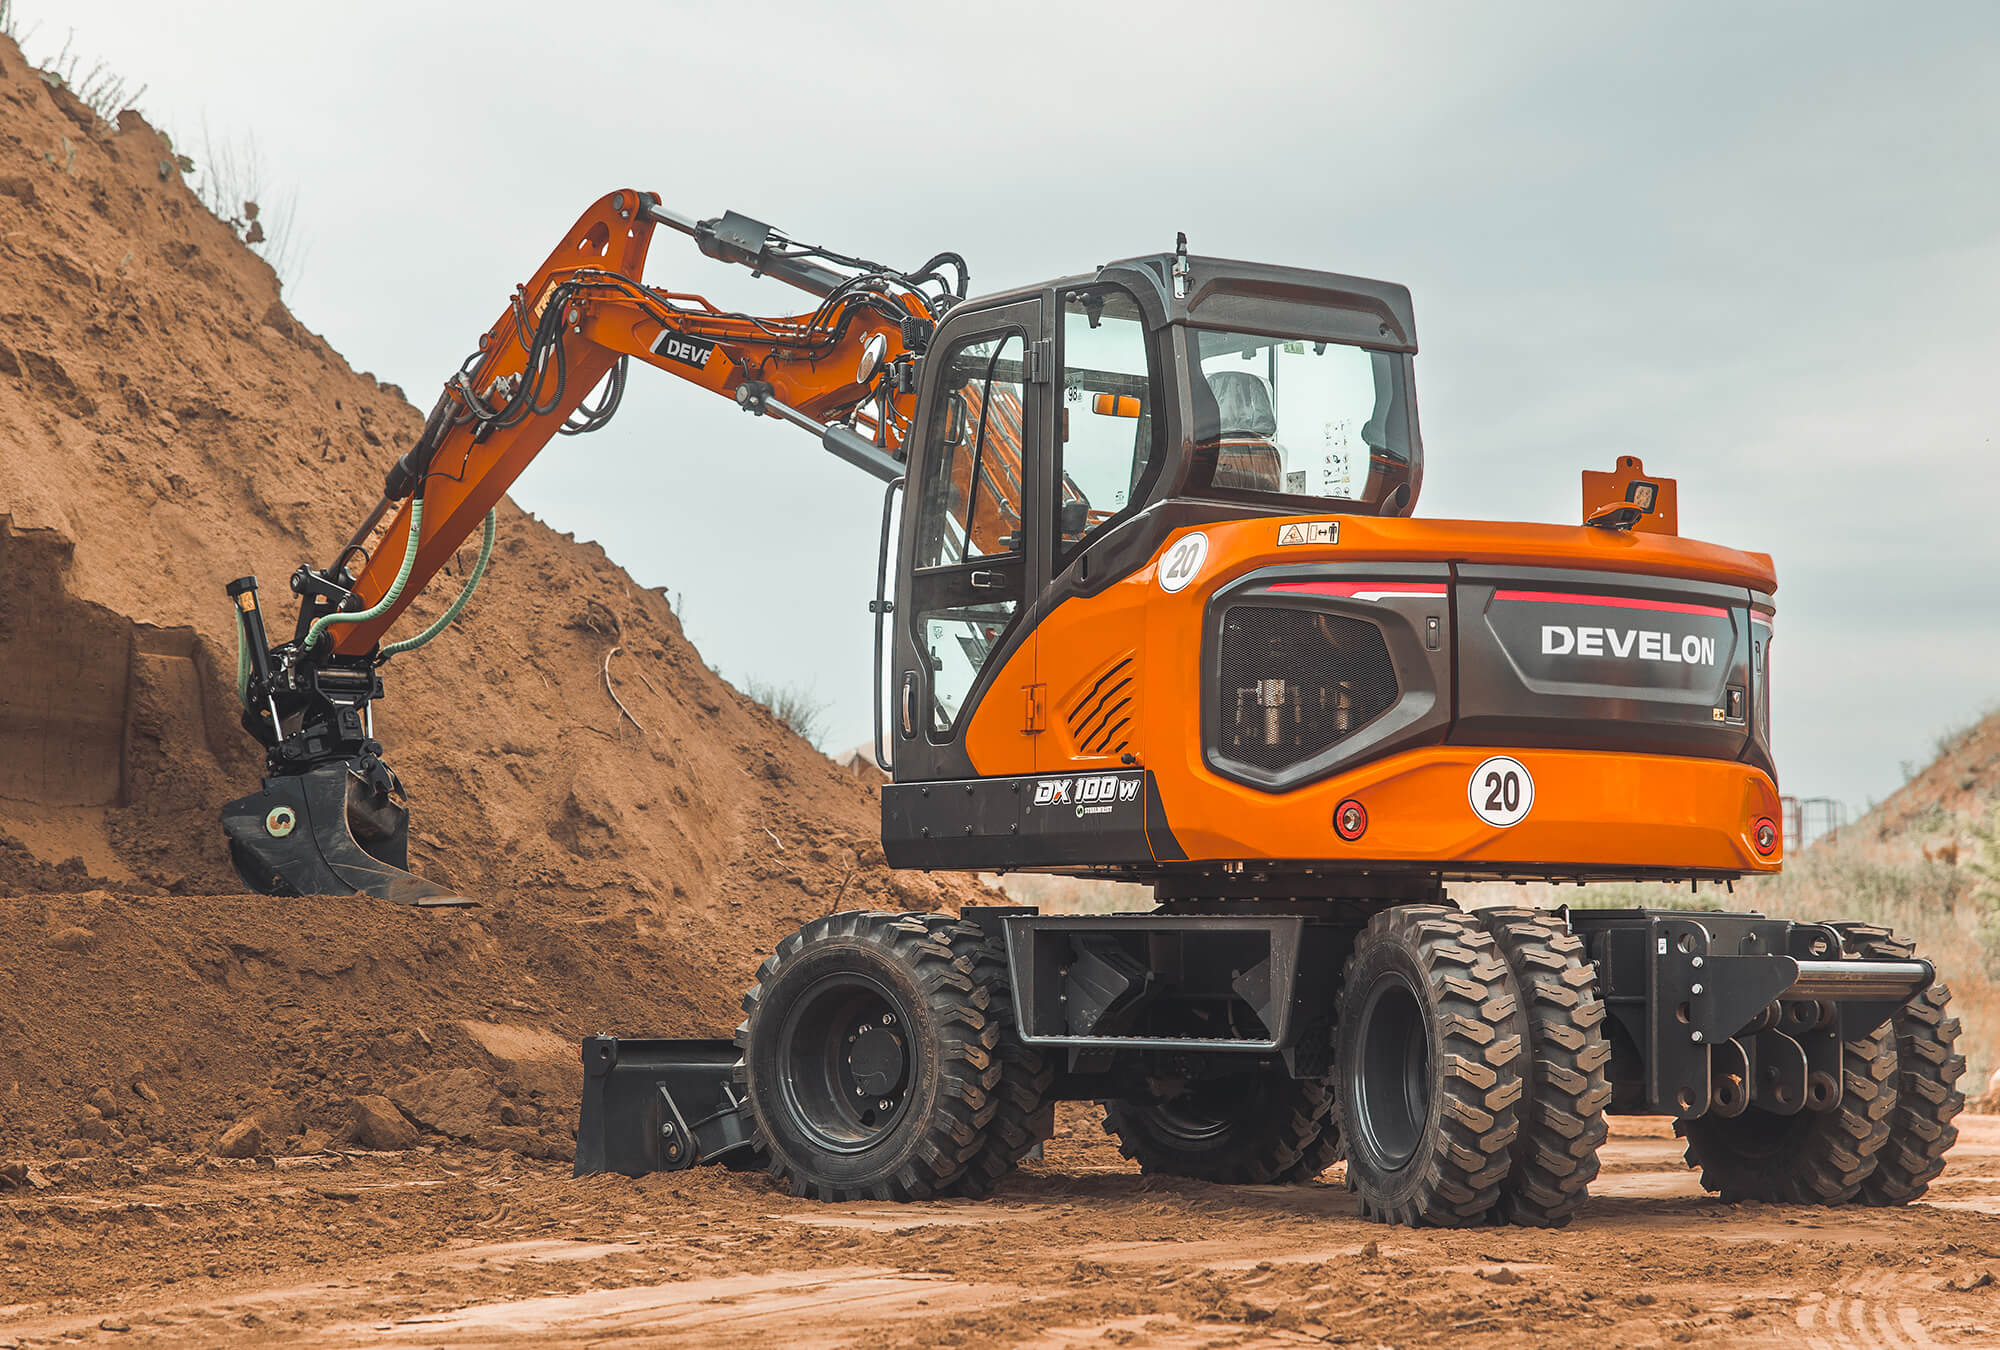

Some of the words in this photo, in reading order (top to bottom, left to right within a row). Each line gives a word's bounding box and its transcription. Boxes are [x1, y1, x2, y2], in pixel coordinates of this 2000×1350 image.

[1166, 542, 1200, 580] 20
[1541, 625, 1715, 666] DEVELON
[1484, 771, 1520, 812] 20
